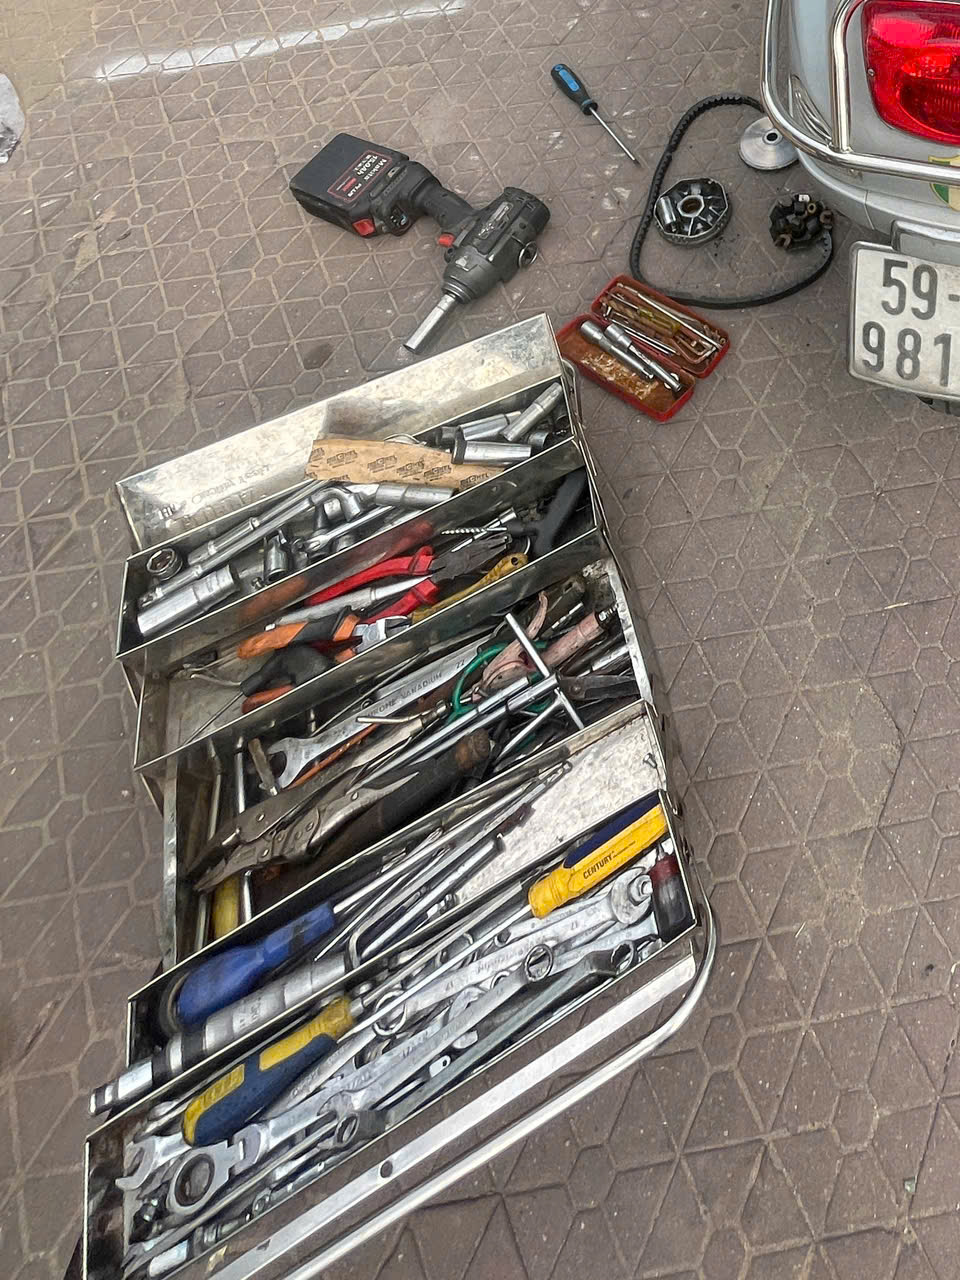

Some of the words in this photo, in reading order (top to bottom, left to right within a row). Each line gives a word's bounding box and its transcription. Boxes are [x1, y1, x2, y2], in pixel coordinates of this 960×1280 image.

[363, 158, 387, 181] Makita
[401, 672, 442, 699] VANADIUM
[583, 853, 613, 879] CENTURY
